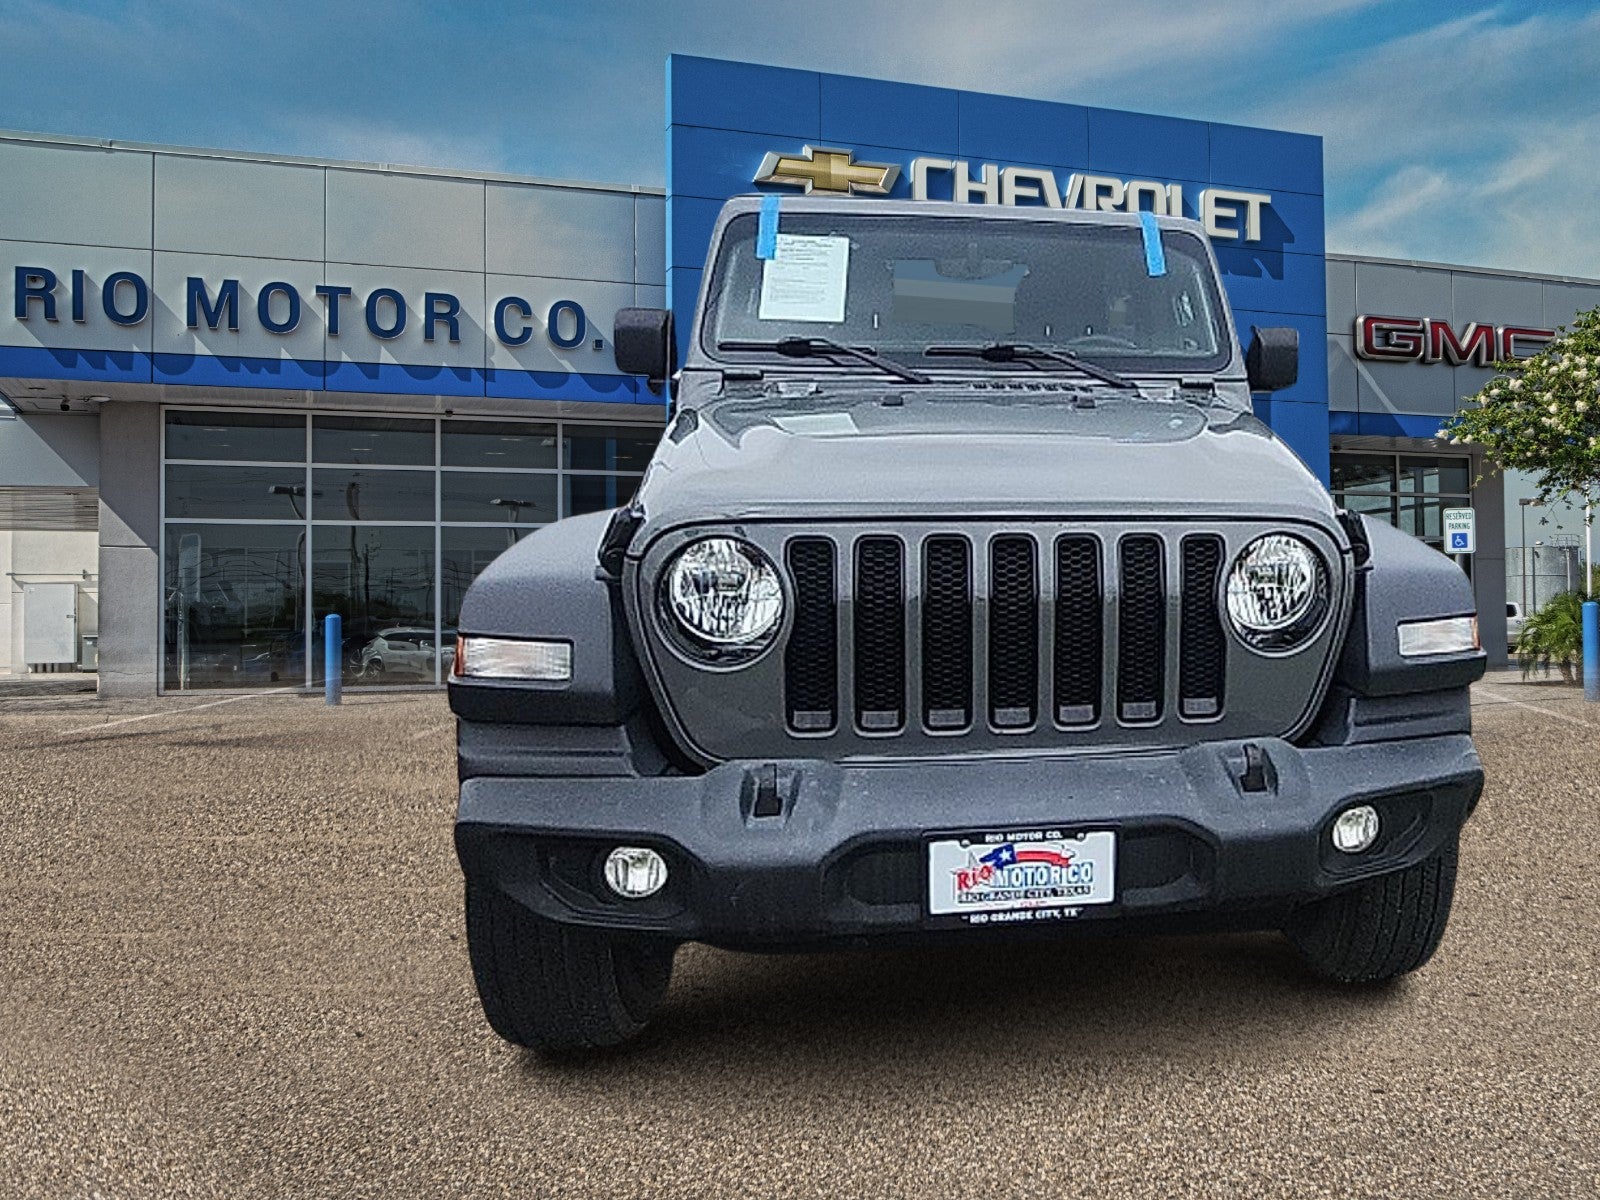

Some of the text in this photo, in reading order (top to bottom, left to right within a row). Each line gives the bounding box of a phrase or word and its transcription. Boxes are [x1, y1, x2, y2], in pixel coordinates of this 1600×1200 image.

[910, 156, 1271, 242] CHEVROLET
[15, 266, 605, 350] RIO MOTOR CO.
[1355, 314, 1558, 366] GMC
[985, 832, 1004, 842] RIO
[1006, 831, 1043, 841] MOTOR
